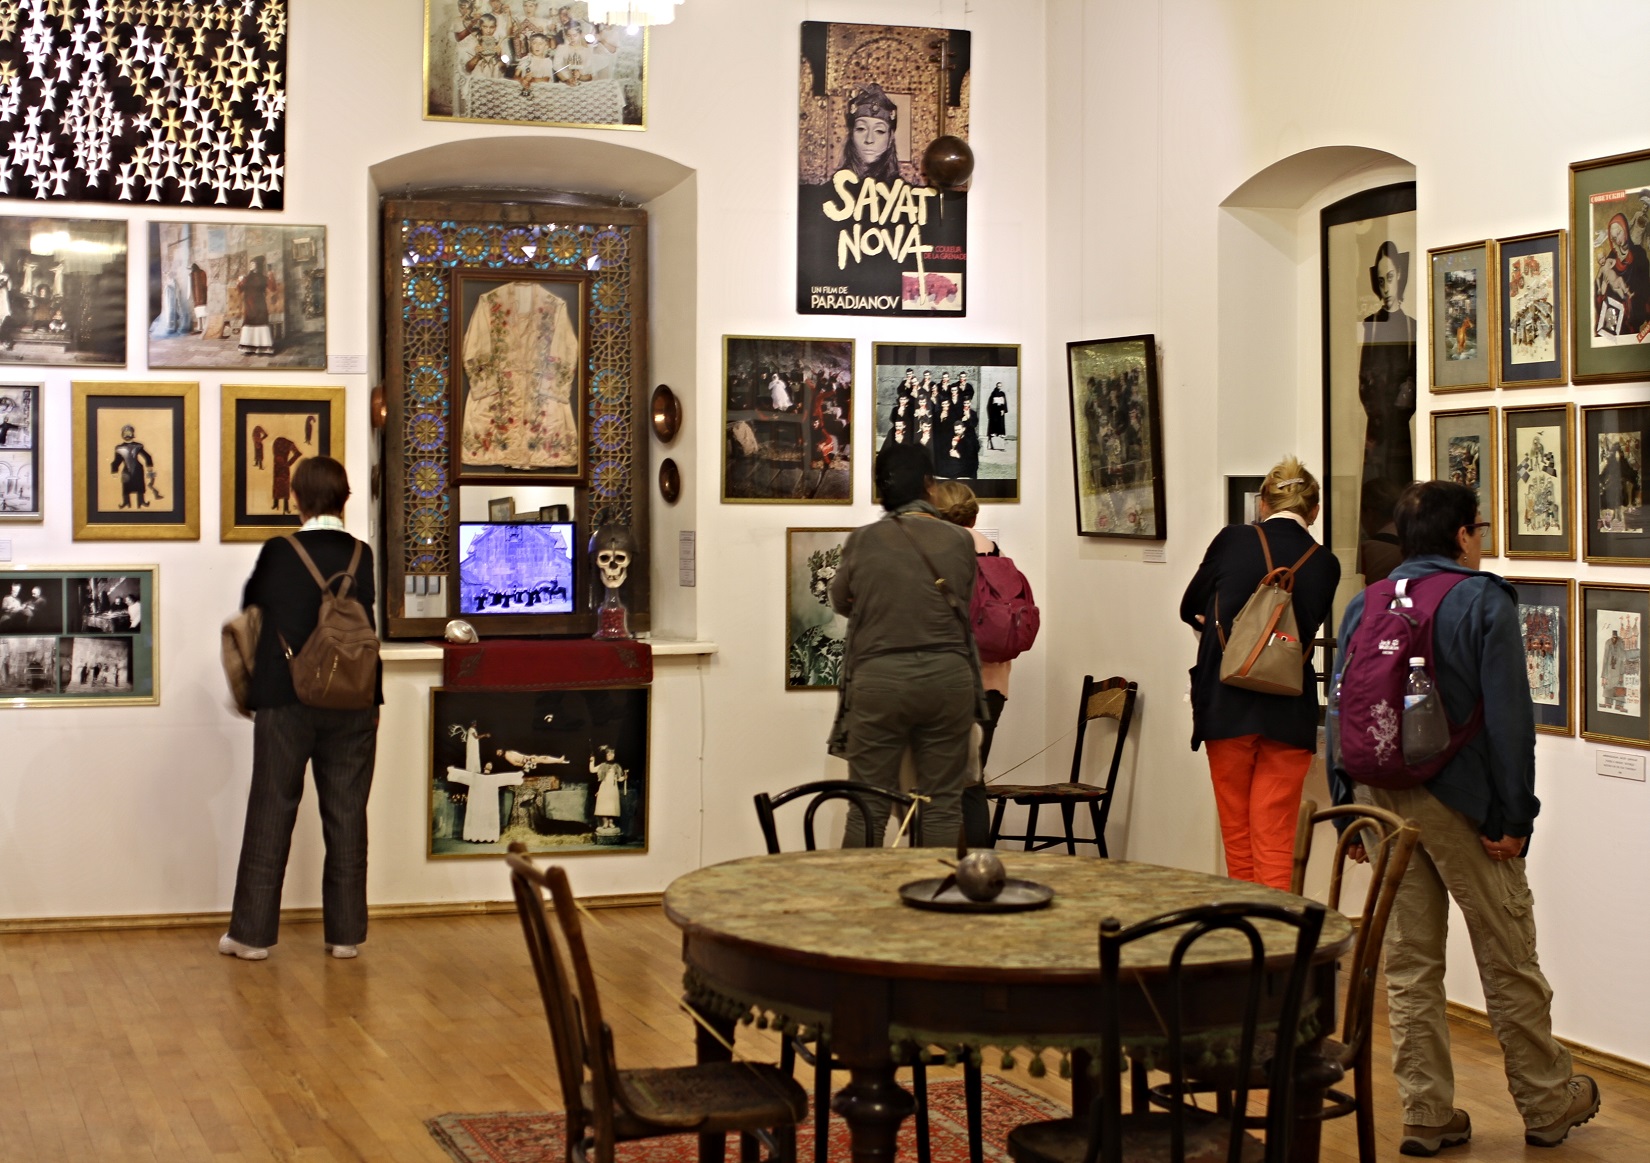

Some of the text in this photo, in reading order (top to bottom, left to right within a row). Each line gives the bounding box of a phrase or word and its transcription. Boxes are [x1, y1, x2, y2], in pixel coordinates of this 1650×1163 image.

[822, 169, 937, 226] SAYAT
[837, 223, 934, 304] NOVA
[923, 252, 932, 260] DE
[811, 286, 849, 294] UN FILM DE
[811, 294, 901, 310] PARADJANOV
